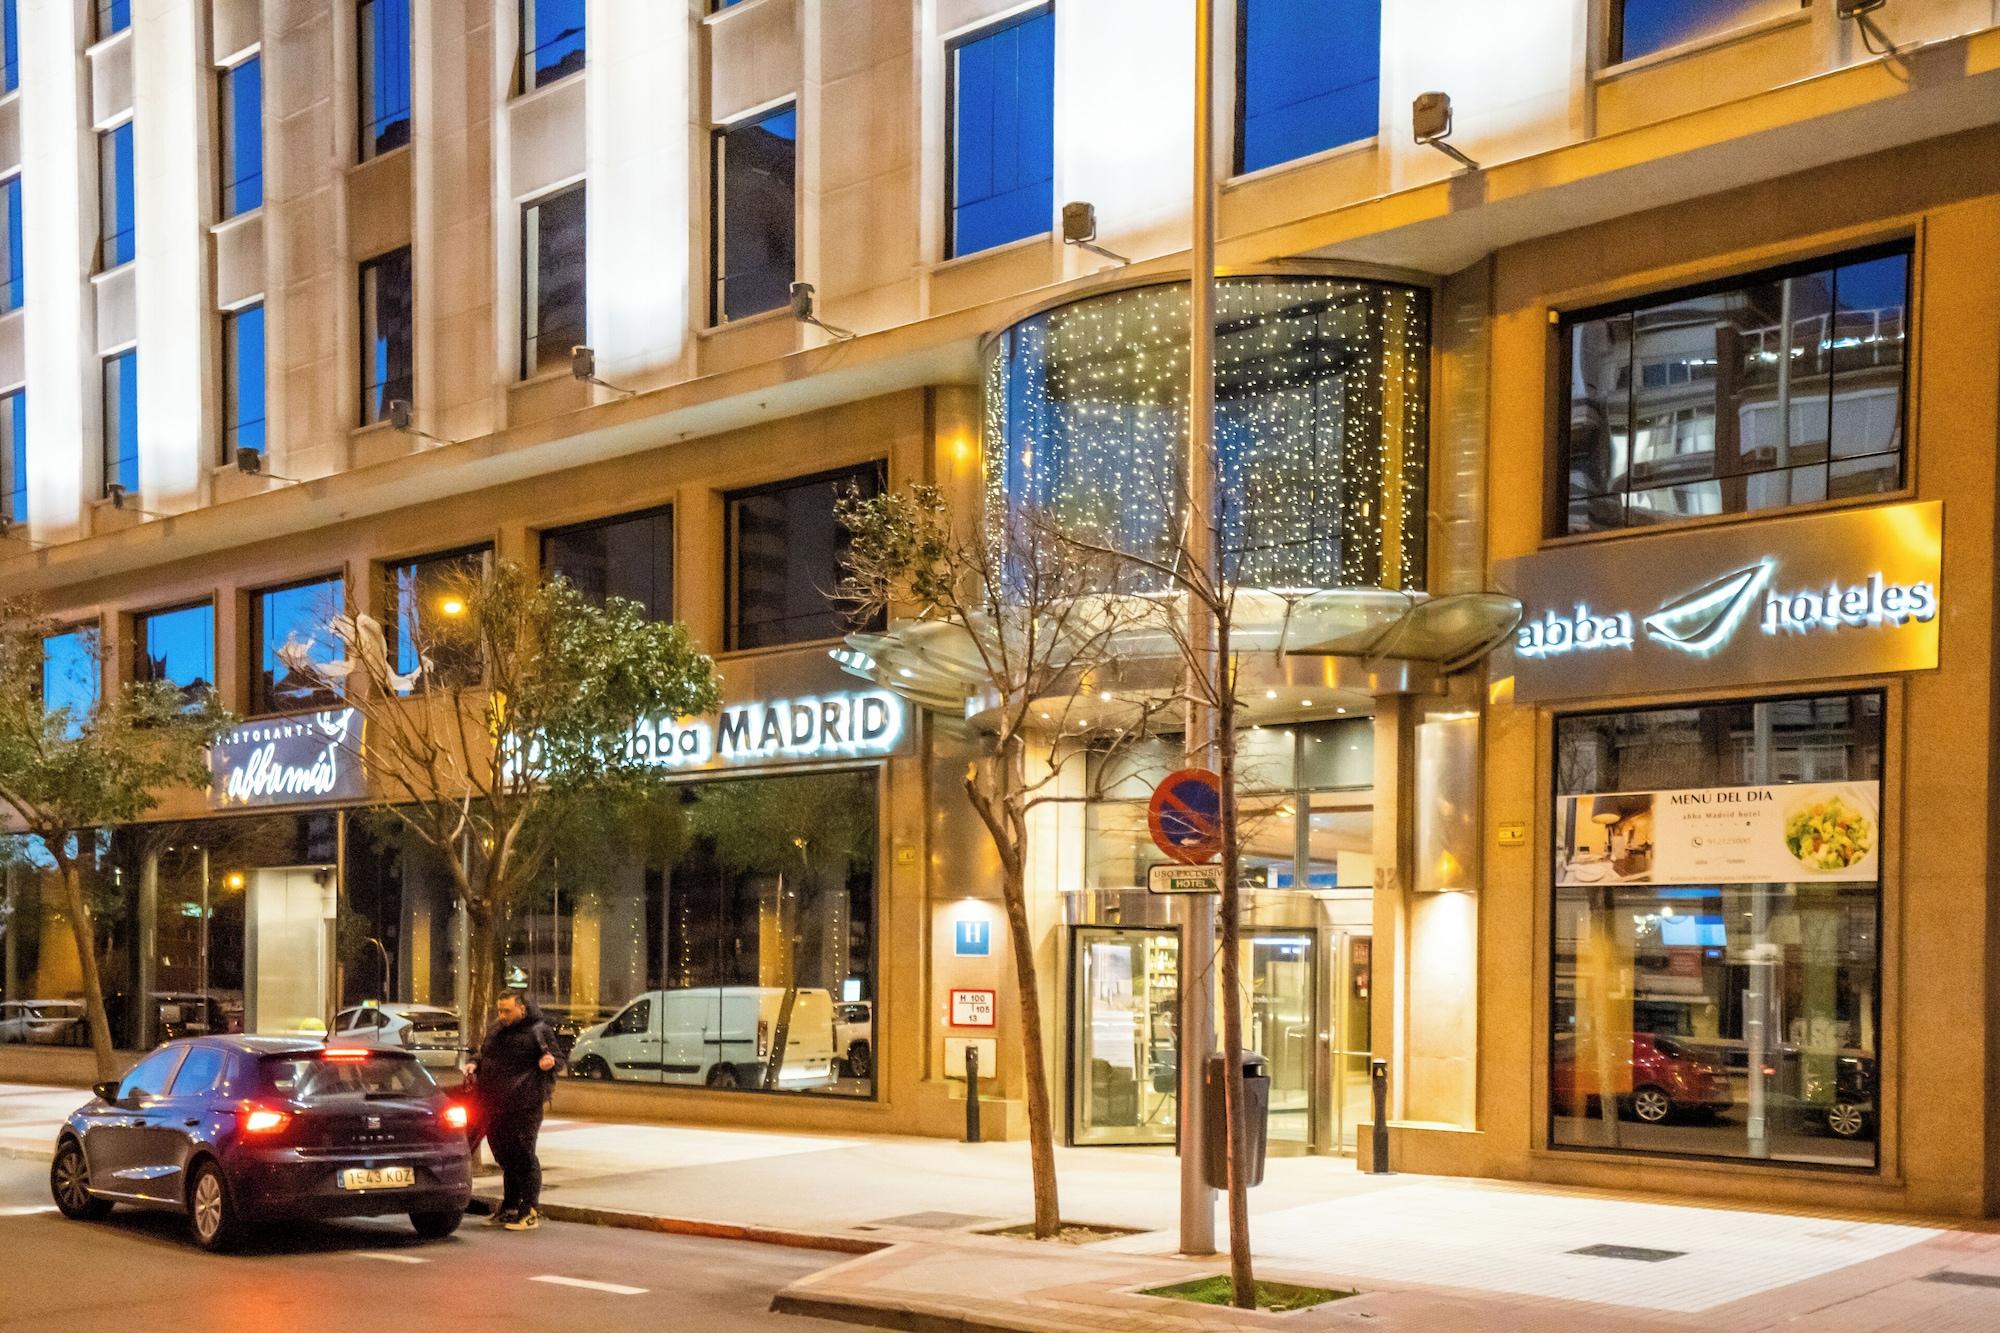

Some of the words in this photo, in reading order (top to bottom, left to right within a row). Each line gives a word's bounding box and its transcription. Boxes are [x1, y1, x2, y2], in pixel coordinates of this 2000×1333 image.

[1517, 606, 1632, 655] abba
[1760, 574, 1936, 630] hoteles
[716, 696, 890, 753] MADRID
[1670, 790, 1712, 805] MENÚ
[1717, 791, 1742, 804] DEL
[1747, 788, 1773, 802] DÍA
[1154, 870, 1174, 878] USO
[1375, 867, 1397, 890] 32
[1176, 880, 1208, 888] HOTEL
[965, 922, 981, 944] H
[350, 1172, 382, 1184] 1543
